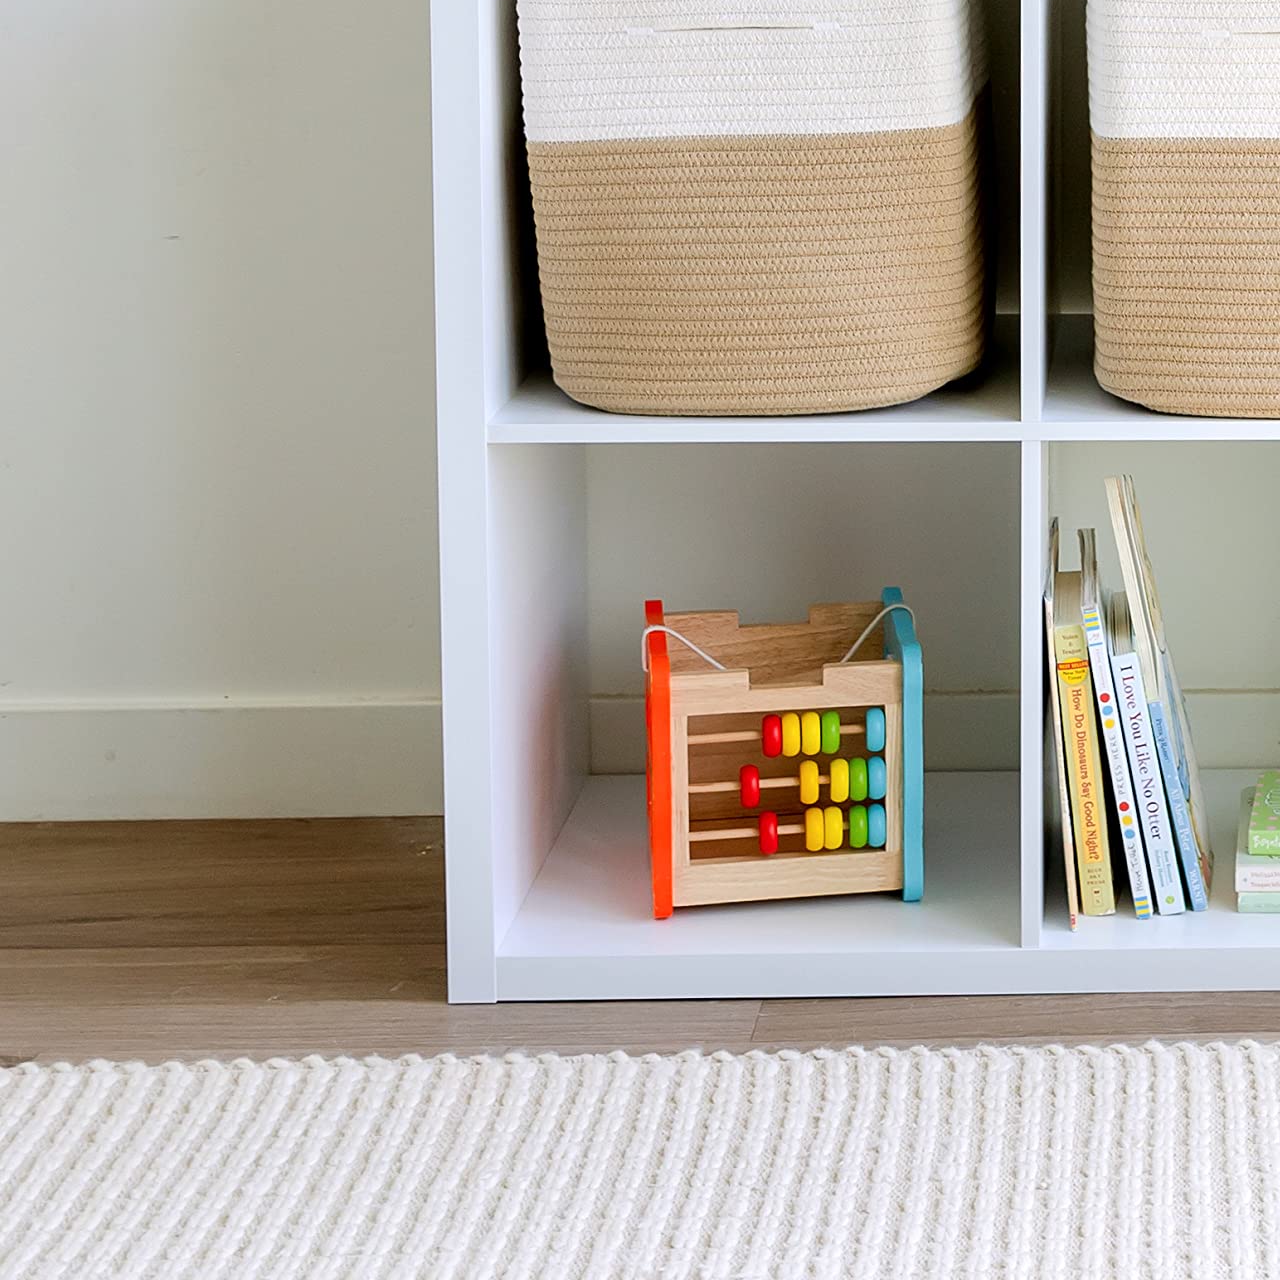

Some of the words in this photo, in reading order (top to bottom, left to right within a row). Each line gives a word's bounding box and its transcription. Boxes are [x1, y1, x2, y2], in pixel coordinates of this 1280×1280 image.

[1072, 688, 1082, 711] How
[1122, 676, 1136, 709] Love
[1074, 713, 1085, 728] Do
[1129, 711, 1143, 739] You
[1076, 731, 1088, 779] Dinosaurs
[1108, 734, 1120, 759] HERE
[1135, 743, 1151, 775] Like
[1080, 782, 1092, 798] Say
[1114, 764, 1126, 796] PRESS
[1141, 778, 1155, 798] No
[1083, 801, 1096, 827] Good
[1146, 801, 1161, 840] Otter
[1085, 830, 1100, 860] Night?
